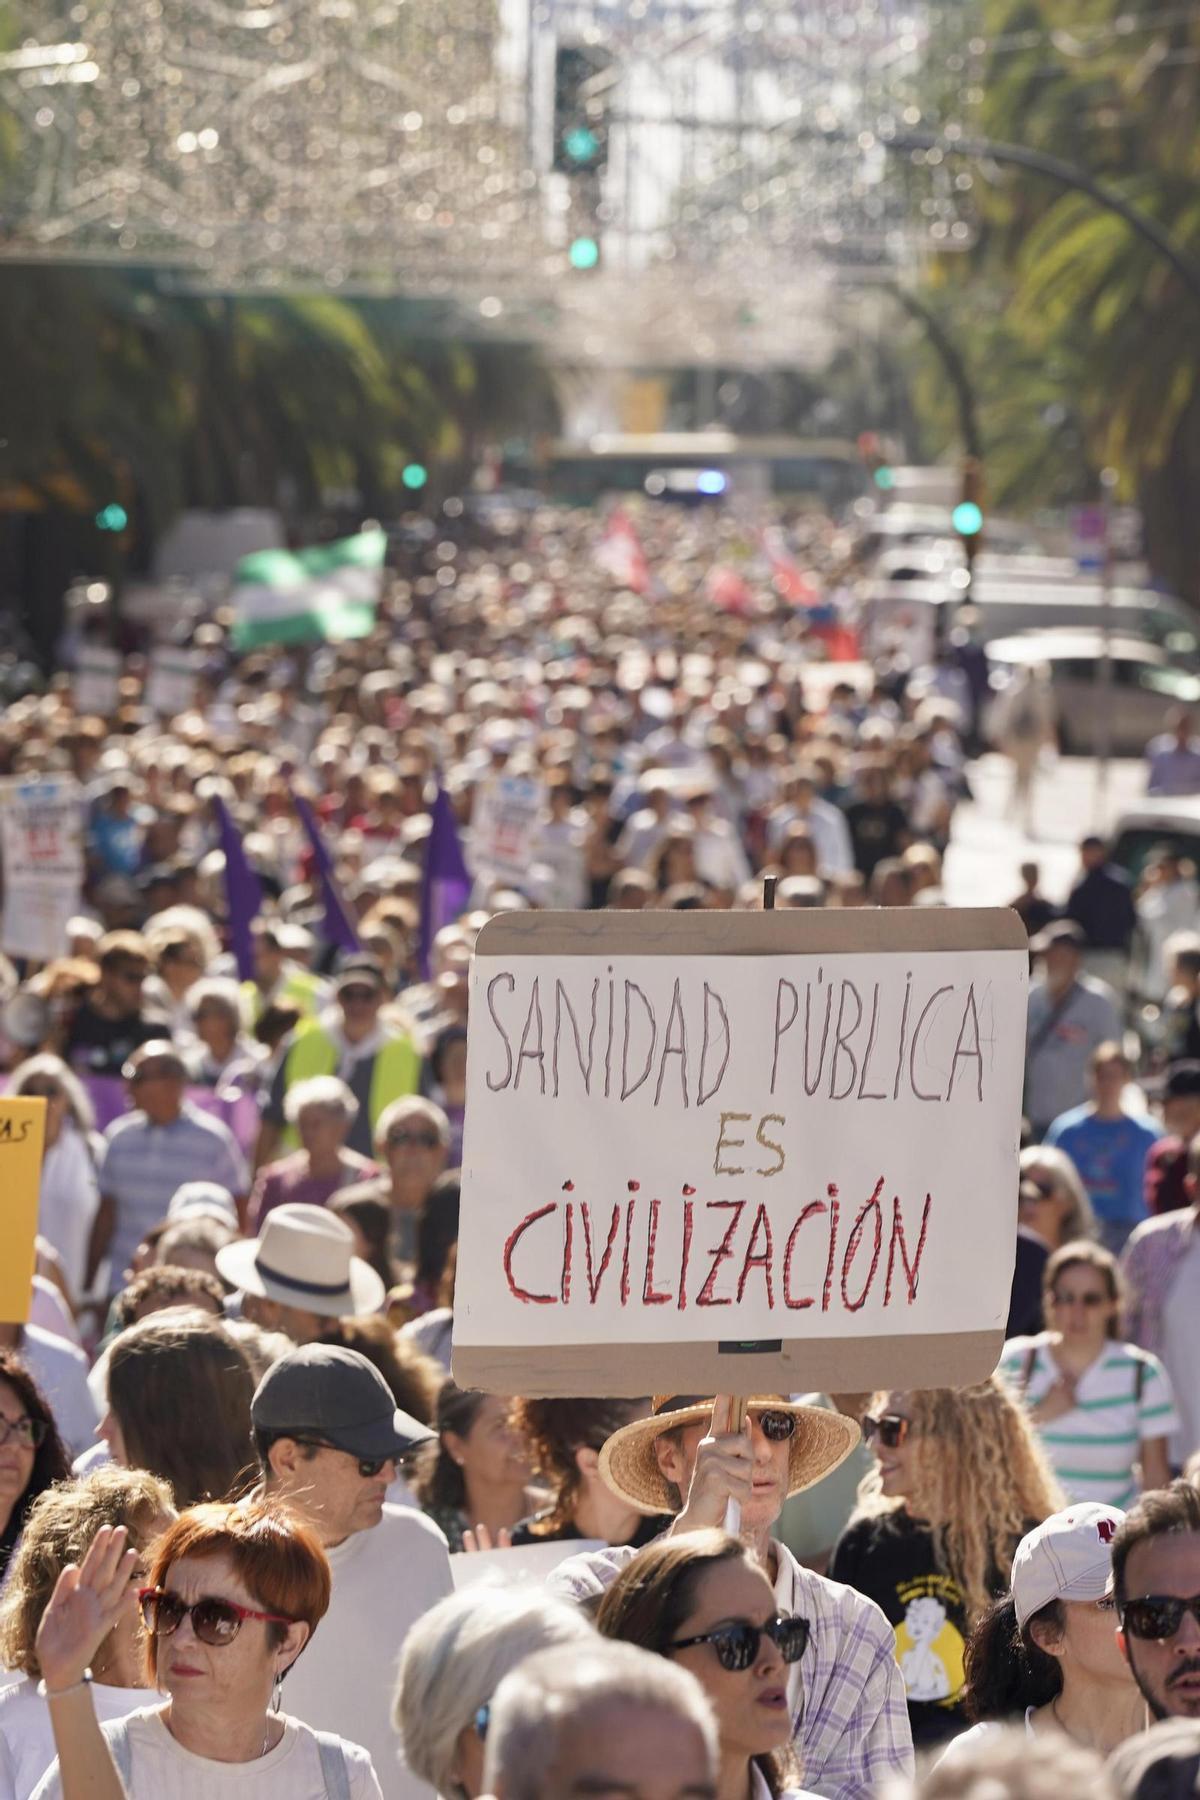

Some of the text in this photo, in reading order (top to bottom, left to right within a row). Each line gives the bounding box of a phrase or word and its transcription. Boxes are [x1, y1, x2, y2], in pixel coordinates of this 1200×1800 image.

[486, 965, 983, 1108] SANIDAD PÚBLICA
[713, 1112, 786, 1177] ES
[503, 1175, 931, 1313] CIVILIZACIÓN
